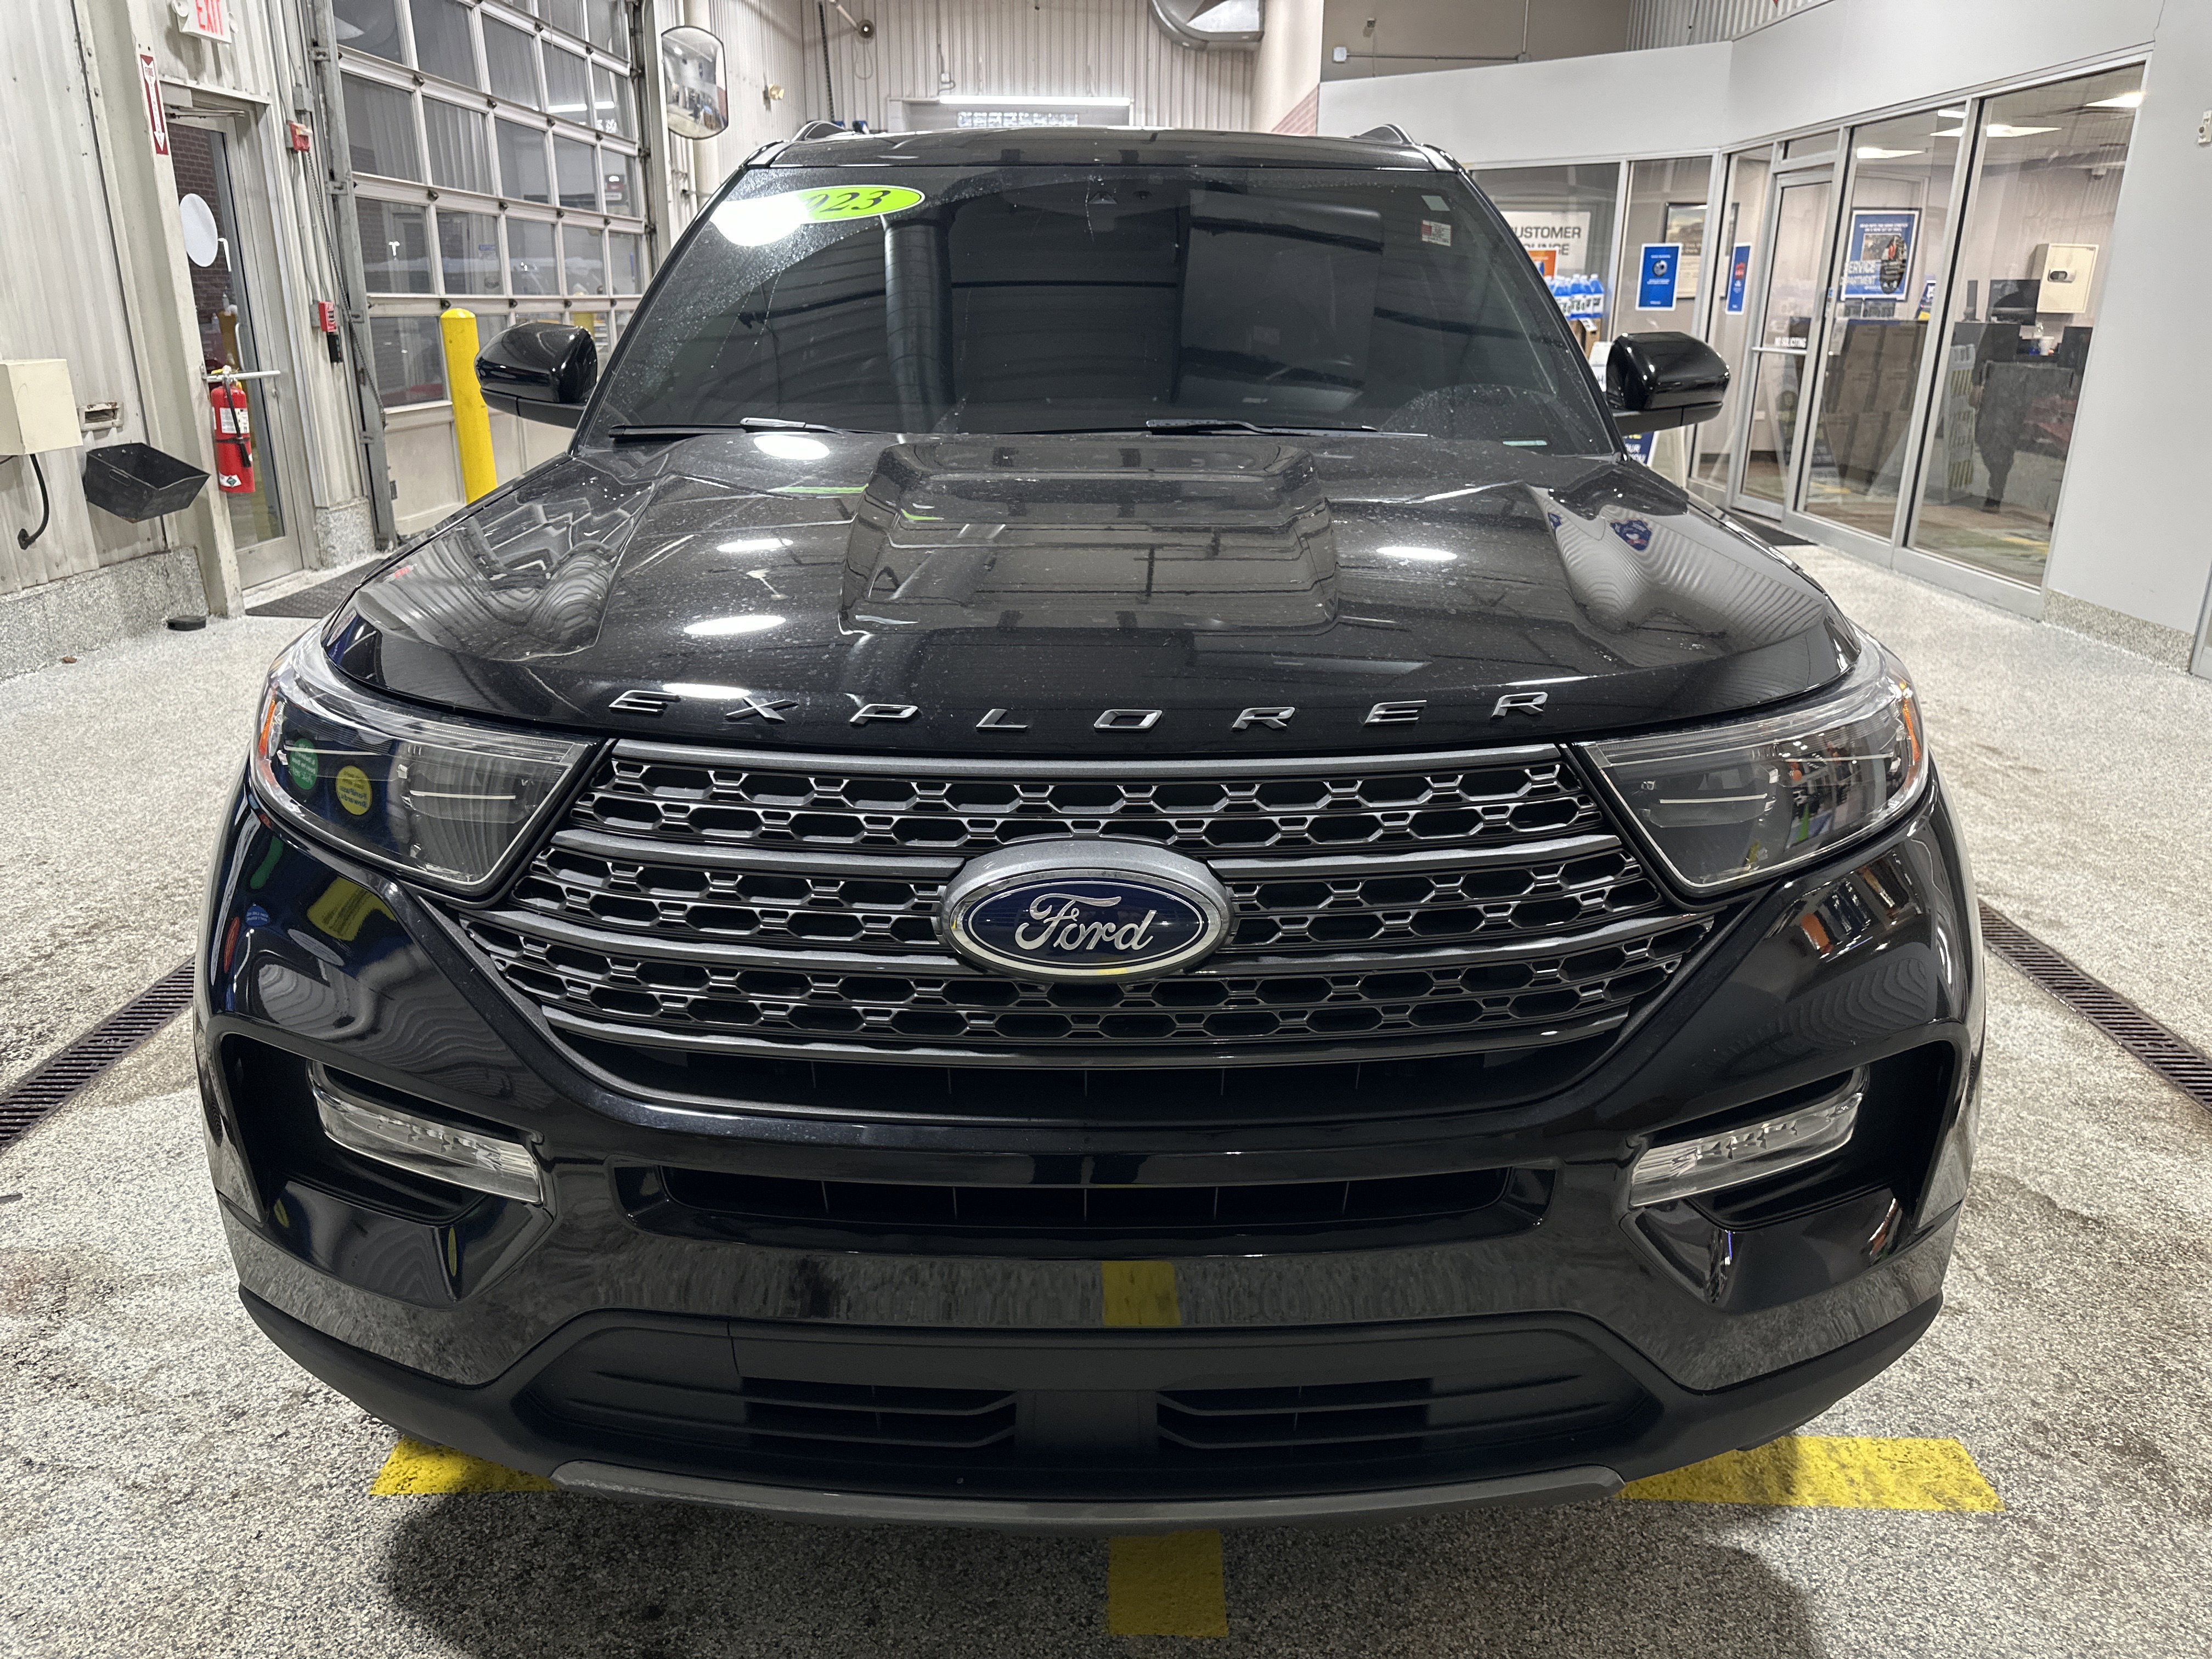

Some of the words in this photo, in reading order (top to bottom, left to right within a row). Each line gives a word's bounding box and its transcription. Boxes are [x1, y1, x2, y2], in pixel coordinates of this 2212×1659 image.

[144, 66, 154, 77] FIRE
[1512, 226, 1582, 239] USTOMER
[608, 689, 1549, 732] EXPLORER
[1014, 893, 1158, 951] Ford
